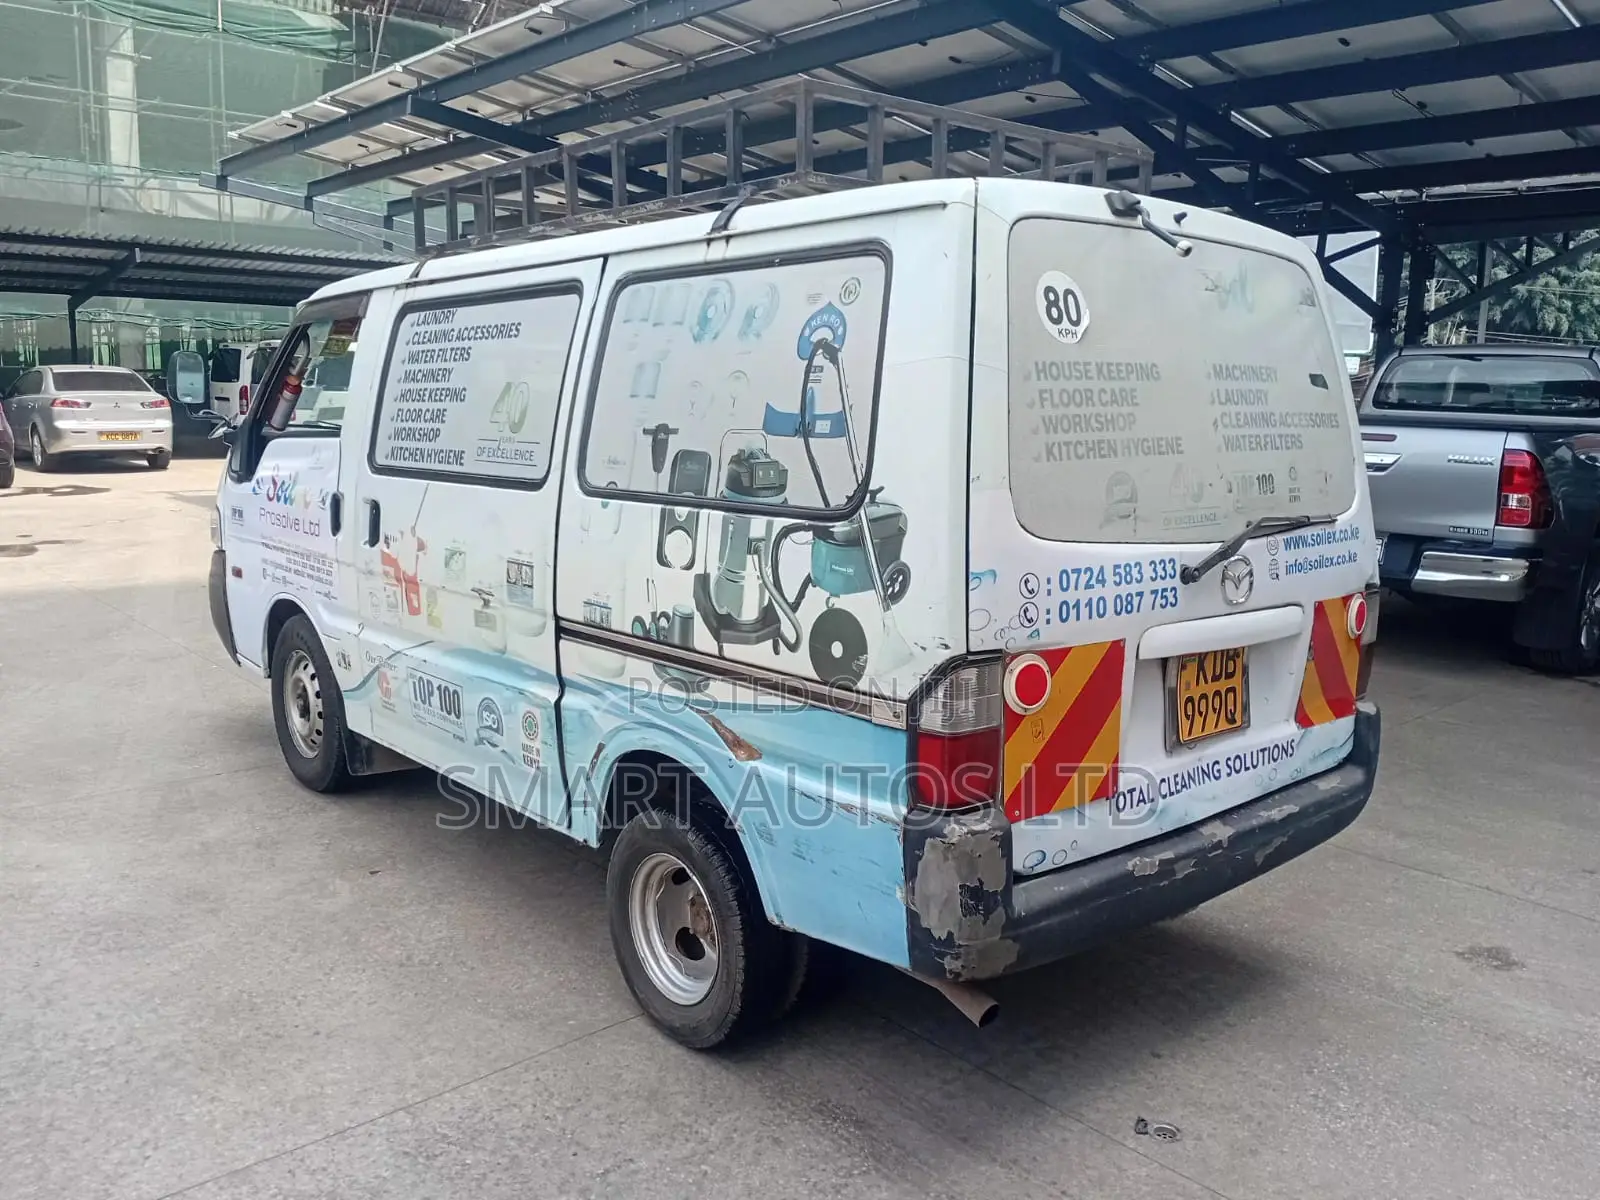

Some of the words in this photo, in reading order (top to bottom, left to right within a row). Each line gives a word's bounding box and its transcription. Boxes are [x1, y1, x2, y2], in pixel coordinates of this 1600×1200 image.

[1044, 285, 1081, 327] 80
[416, 309, 458, 327] LAUNDRY
[411, 328, 455, 346] CLEANING
[455, 322, 522, 342] ACCESSORIES
[1057, 327, 1078, 339] KPH
[407, 348, 436, 365] WATER
[436, 346, 472, 363] FILTERS
[403, 367, 454, 384] MACHINERY
[1034, 361, 1094, 381] HOUSE
[1094, 362, 1161, 382] KEEPING
[1212, 363, 1278, 382] MACHINERY
[399, 387, 427, 402] HOUSE
[427, 387, 467, 403] KEEPING
[1038, 388, 1096, 409] FLOOR
[1097, 387, 1140, 407] CARE
[1216, 388, 1269, 406] LAUNDRY
[395, 408, 423, 423] FLOOR
[422, 408, 447, 423] CARE
[1041, 412, 1137, 434] WORKSHOP
[1219, 411, 1277, 429] CLEANING
[1278, 412, 1340, 429] ACCESSORIES
[392, 427, 441, 442] WORKSHOP
[1222, 434, 1263, 452] WATER
[1262, 433, 1303, 451] FILTERS
[390, 445, 427, 464] KITCHEN
[426, 447, 466, 466] HYGIENE
[477, 446, 487, 457] OF
[487, 448, 535, 462] EXCELLENCE
[1044, 439, 1118, 462] KITCHEN
[1118, 436, 1184, 457] HYGIENE
[1256, 472, 1275, 496] 100
[259, 507, 300, 532] Prosolve
[302, 519, 320, 537] Ltd
[1283, 524, 1360, 551] www.soilex.co.ke
[1285, 550, 1358, 576] info@soilex.co.ke
[1058, 565, 1107, 593] 0724
[1112, 561, 1144, 587] 583
[1149, 557, 1177, 583] 333
[1058, 596, 1108, 624] 0110
[1113, 591, 1145, 617] 087
[1150, 586, 1179, 611] 753
[1195, 648, 1238, 687] KDB
[412, 676, 434, 708] TOP
[436, 684, 461, 720] 100
[1184, 686, 1237, 737] 999Q
[1105, 786, 1155, 816] TOTAL
[1158, 760, 1222, 799] CLEANING
[1225, 738, 1296, 778] SOLUTIONS
